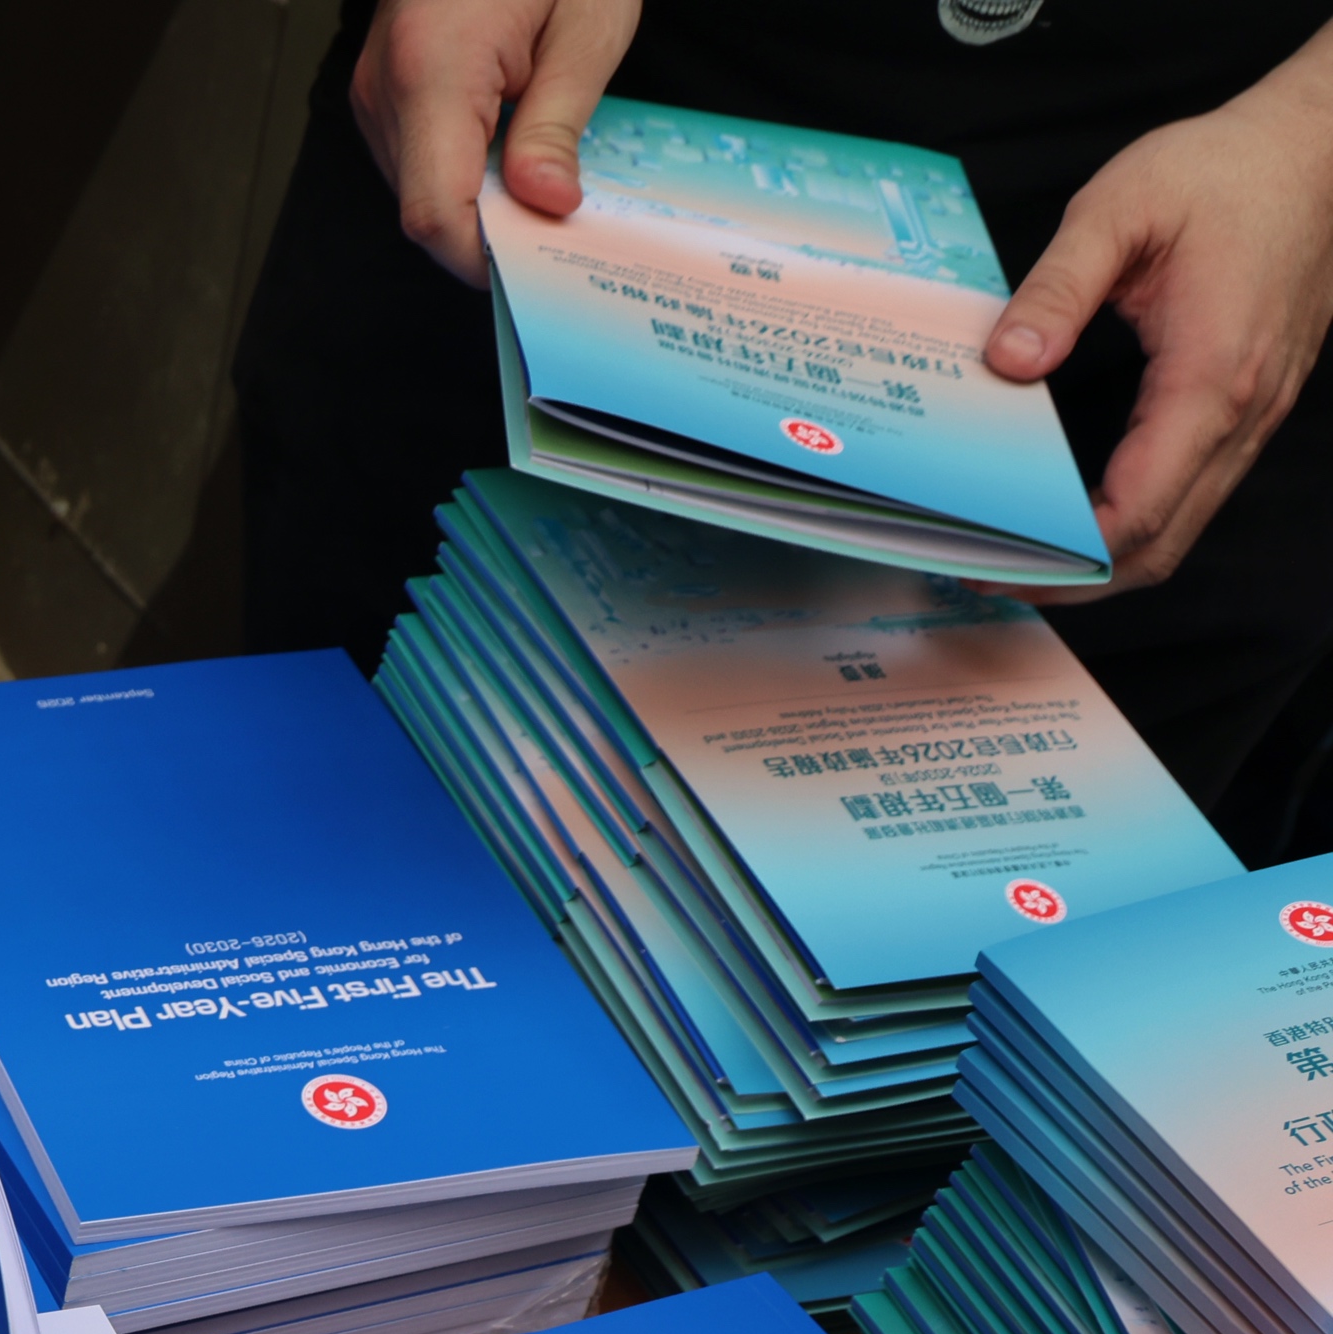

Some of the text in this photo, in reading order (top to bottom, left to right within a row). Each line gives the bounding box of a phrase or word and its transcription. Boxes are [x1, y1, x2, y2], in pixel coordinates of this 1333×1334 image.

[763, 729, 1078, 778] 行政長官2026年施政報告
[840, 775, 1072, 821] 第一個五年規劃
[45, 932, 463, 988] of the Hong Kong Special Administrative Region
[100, 953, 431, 1000] for Economic and Social Development
[1279, 976, 1306, 990] Hong
[1307, 970, 1329, 984] Kong
[64, 967, 497, 1031] The First Five-Year Plan
[194, 1045, 447, 1081] The Hong Kong Special Administrative Region
[223, 1057, 258, 1067] China
[1279, 1162, 1314, 1177] The
[1284, 1172, 1331, 1195] of the
